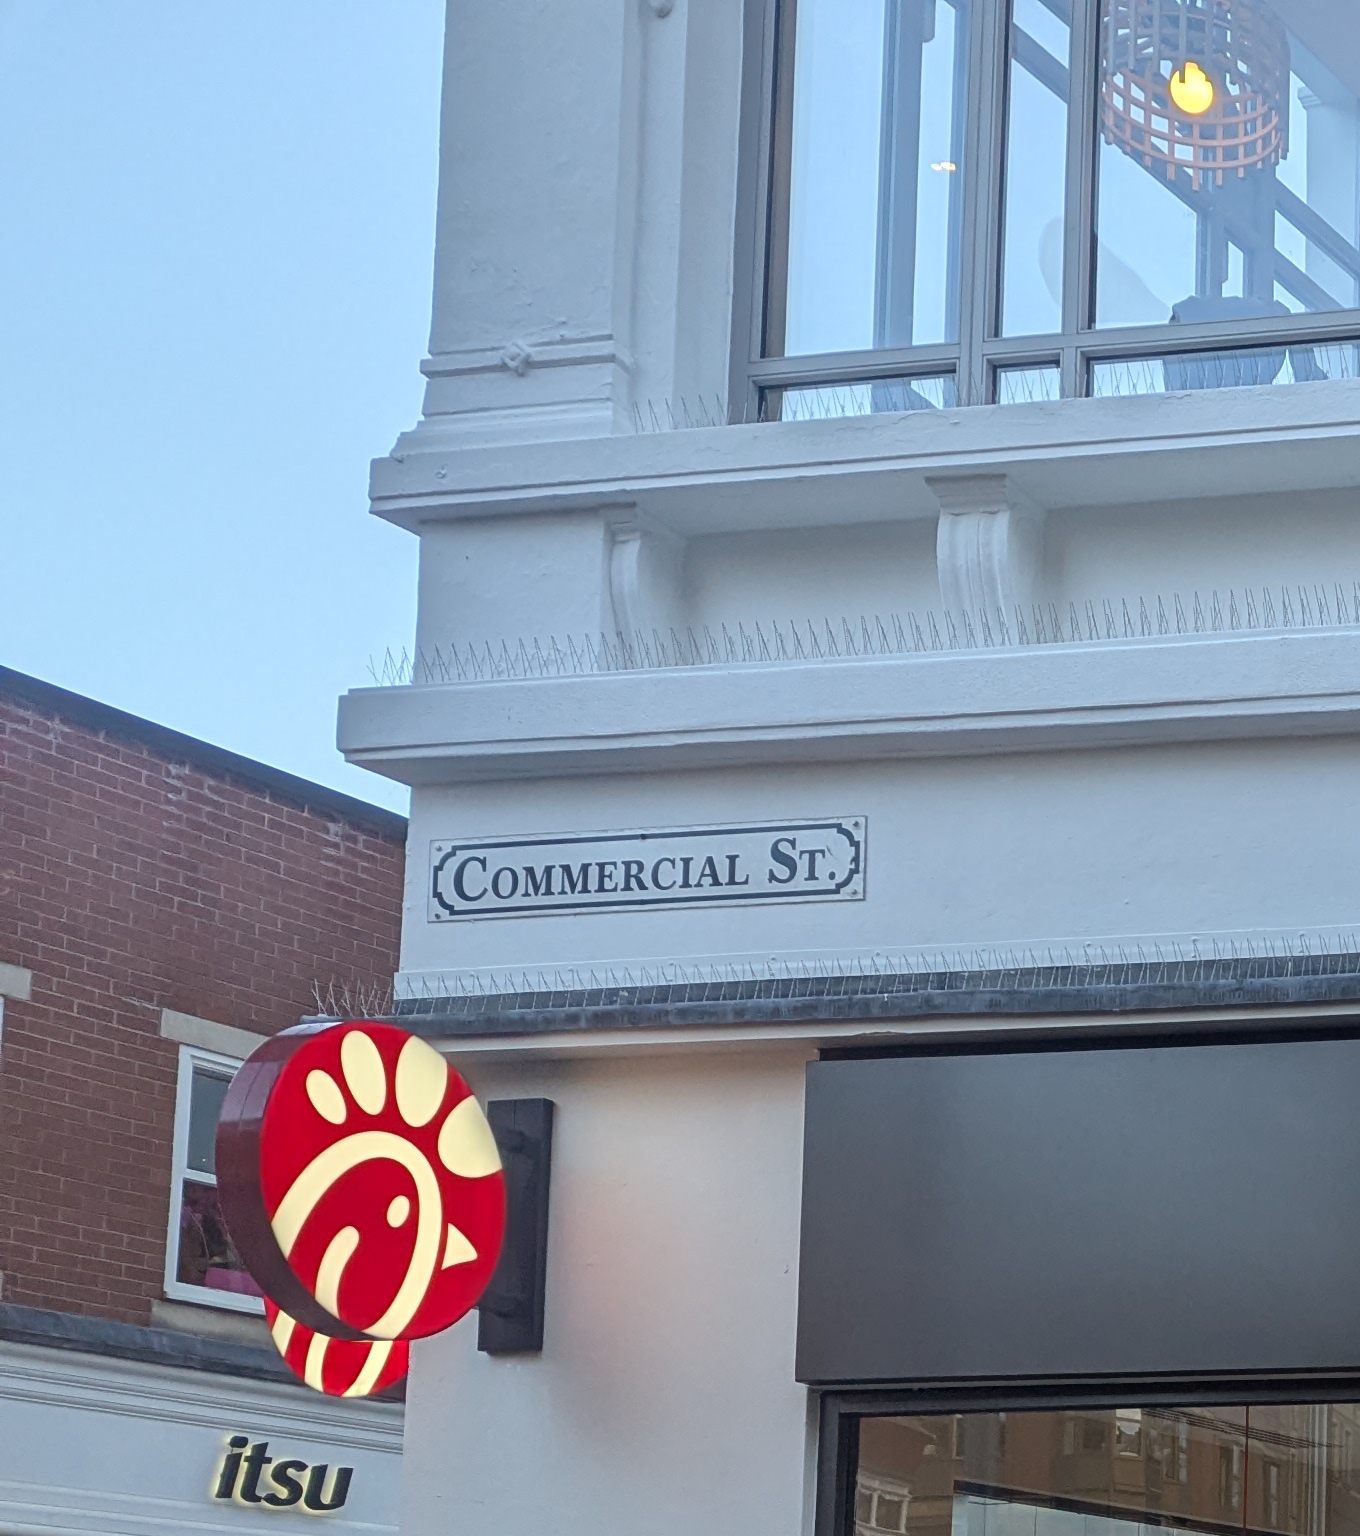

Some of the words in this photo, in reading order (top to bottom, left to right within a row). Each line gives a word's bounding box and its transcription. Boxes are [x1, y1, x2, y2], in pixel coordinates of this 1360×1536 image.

[453, 854, 749, 902] COMMERCIAL
[768, 837, 837, 885] ST.
[214, 1435, 354, 1511] itsu
